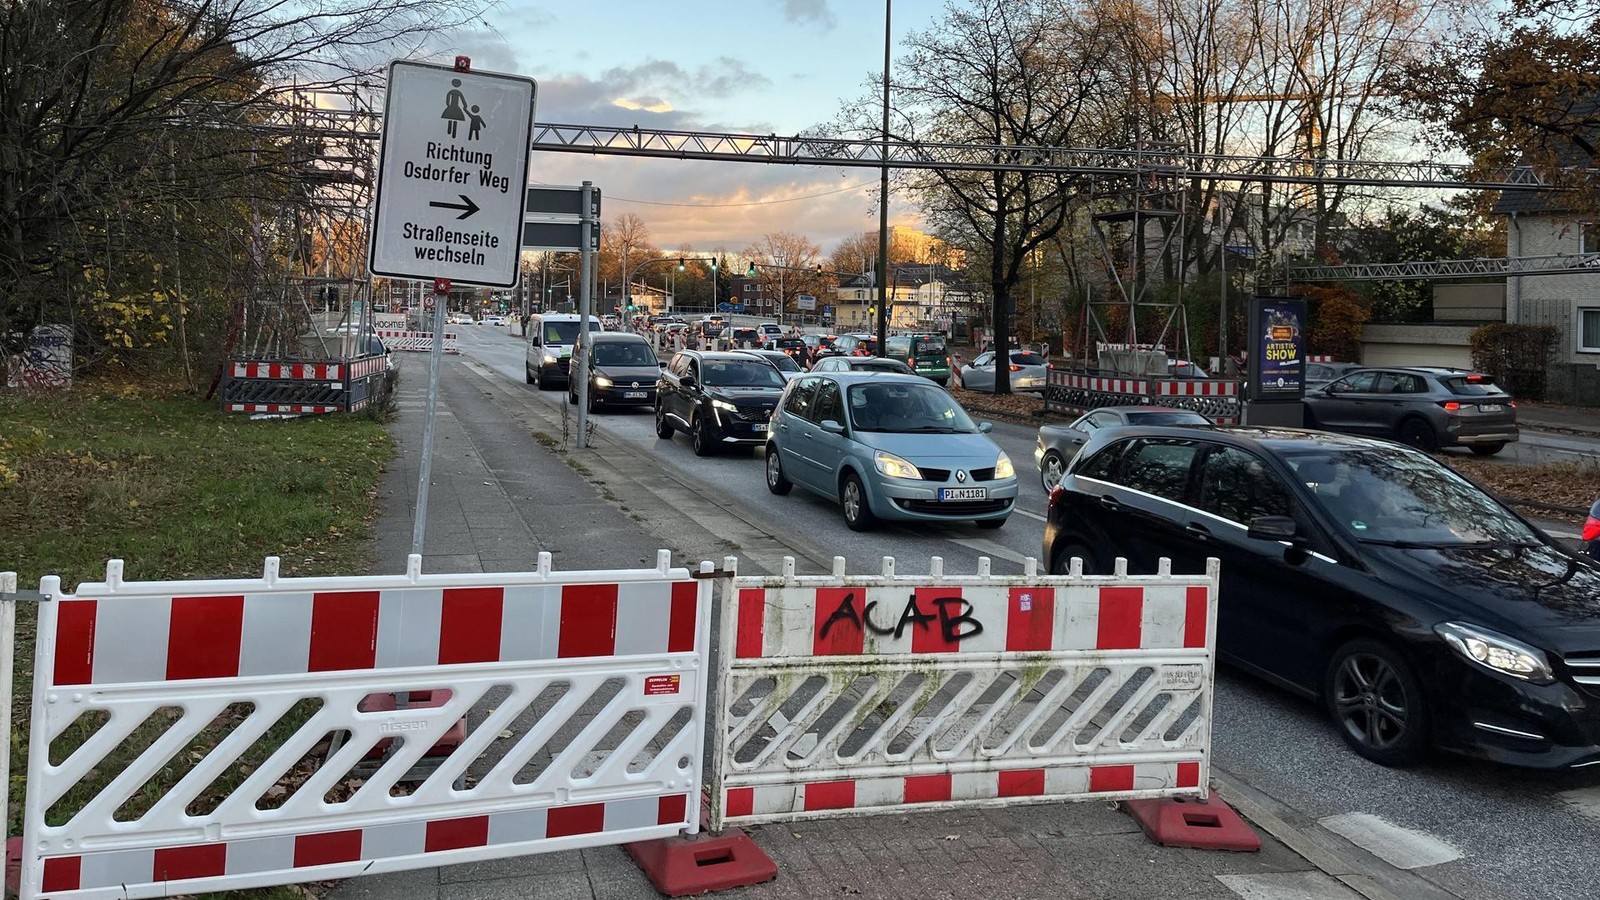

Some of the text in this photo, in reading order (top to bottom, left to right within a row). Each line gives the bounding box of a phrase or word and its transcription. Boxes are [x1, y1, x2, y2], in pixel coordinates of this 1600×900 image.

[427, 141, 492, 170] Richtung
[404, 161, 510, 193] Osdorfer Weg
[403, 222, 499, 248] Straßenseite
[414, 246, 485, 265] wechseln
[1266, 349, 1297, 360] SHOW
[820, 593, 984, 642] ACAB
[380, 717, 428, 732] nissen
